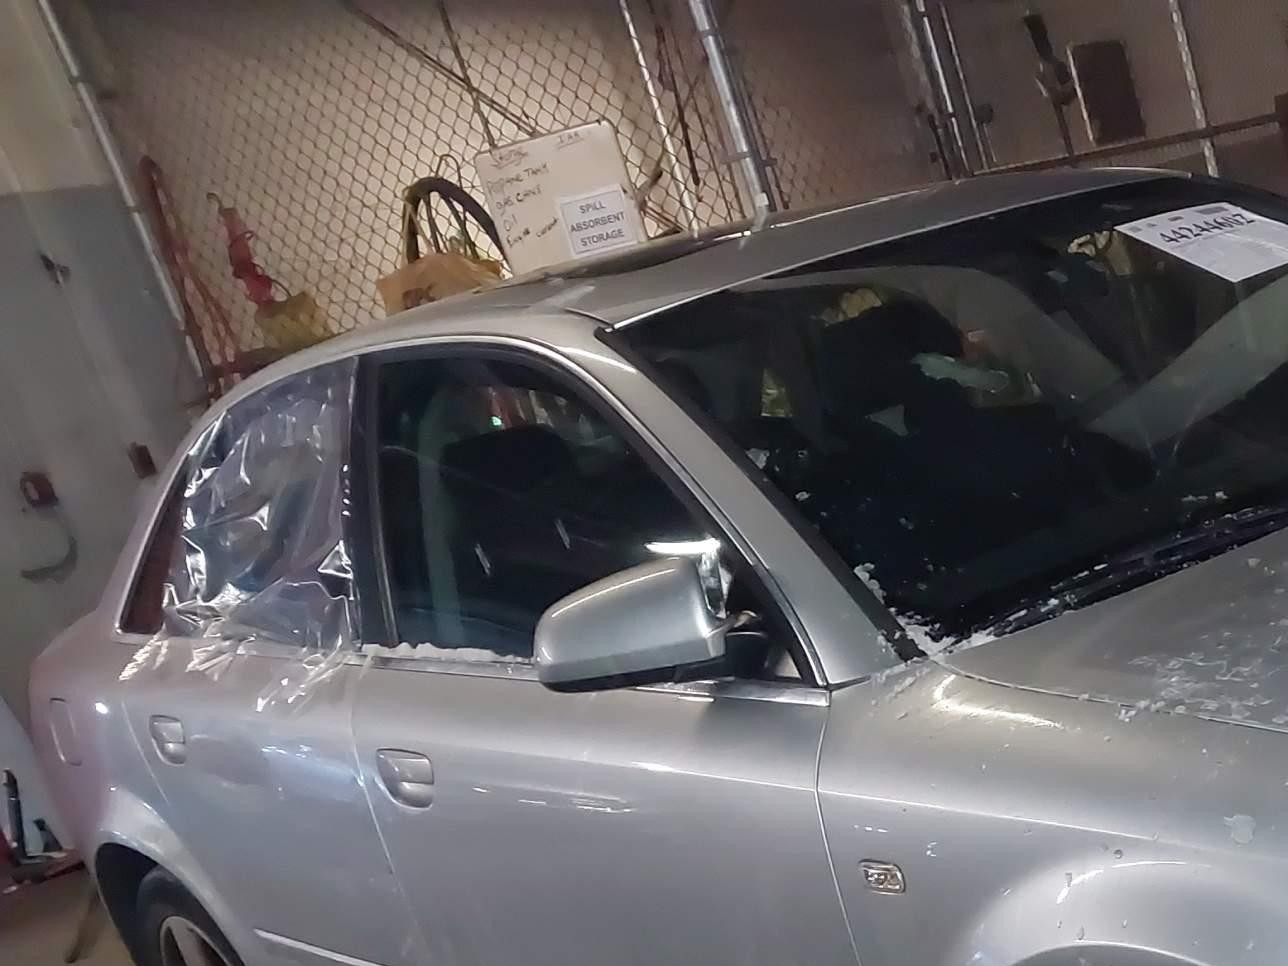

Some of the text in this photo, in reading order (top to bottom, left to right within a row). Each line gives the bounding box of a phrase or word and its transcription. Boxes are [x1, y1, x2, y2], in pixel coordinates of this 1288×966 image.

[579, 200, 607, 214] SPILL
[570, 211, 625, 233] ABSORBENT
[1160, 213, 1256, 243] 44244602
[580, 228, 625, 247] STORAGE
